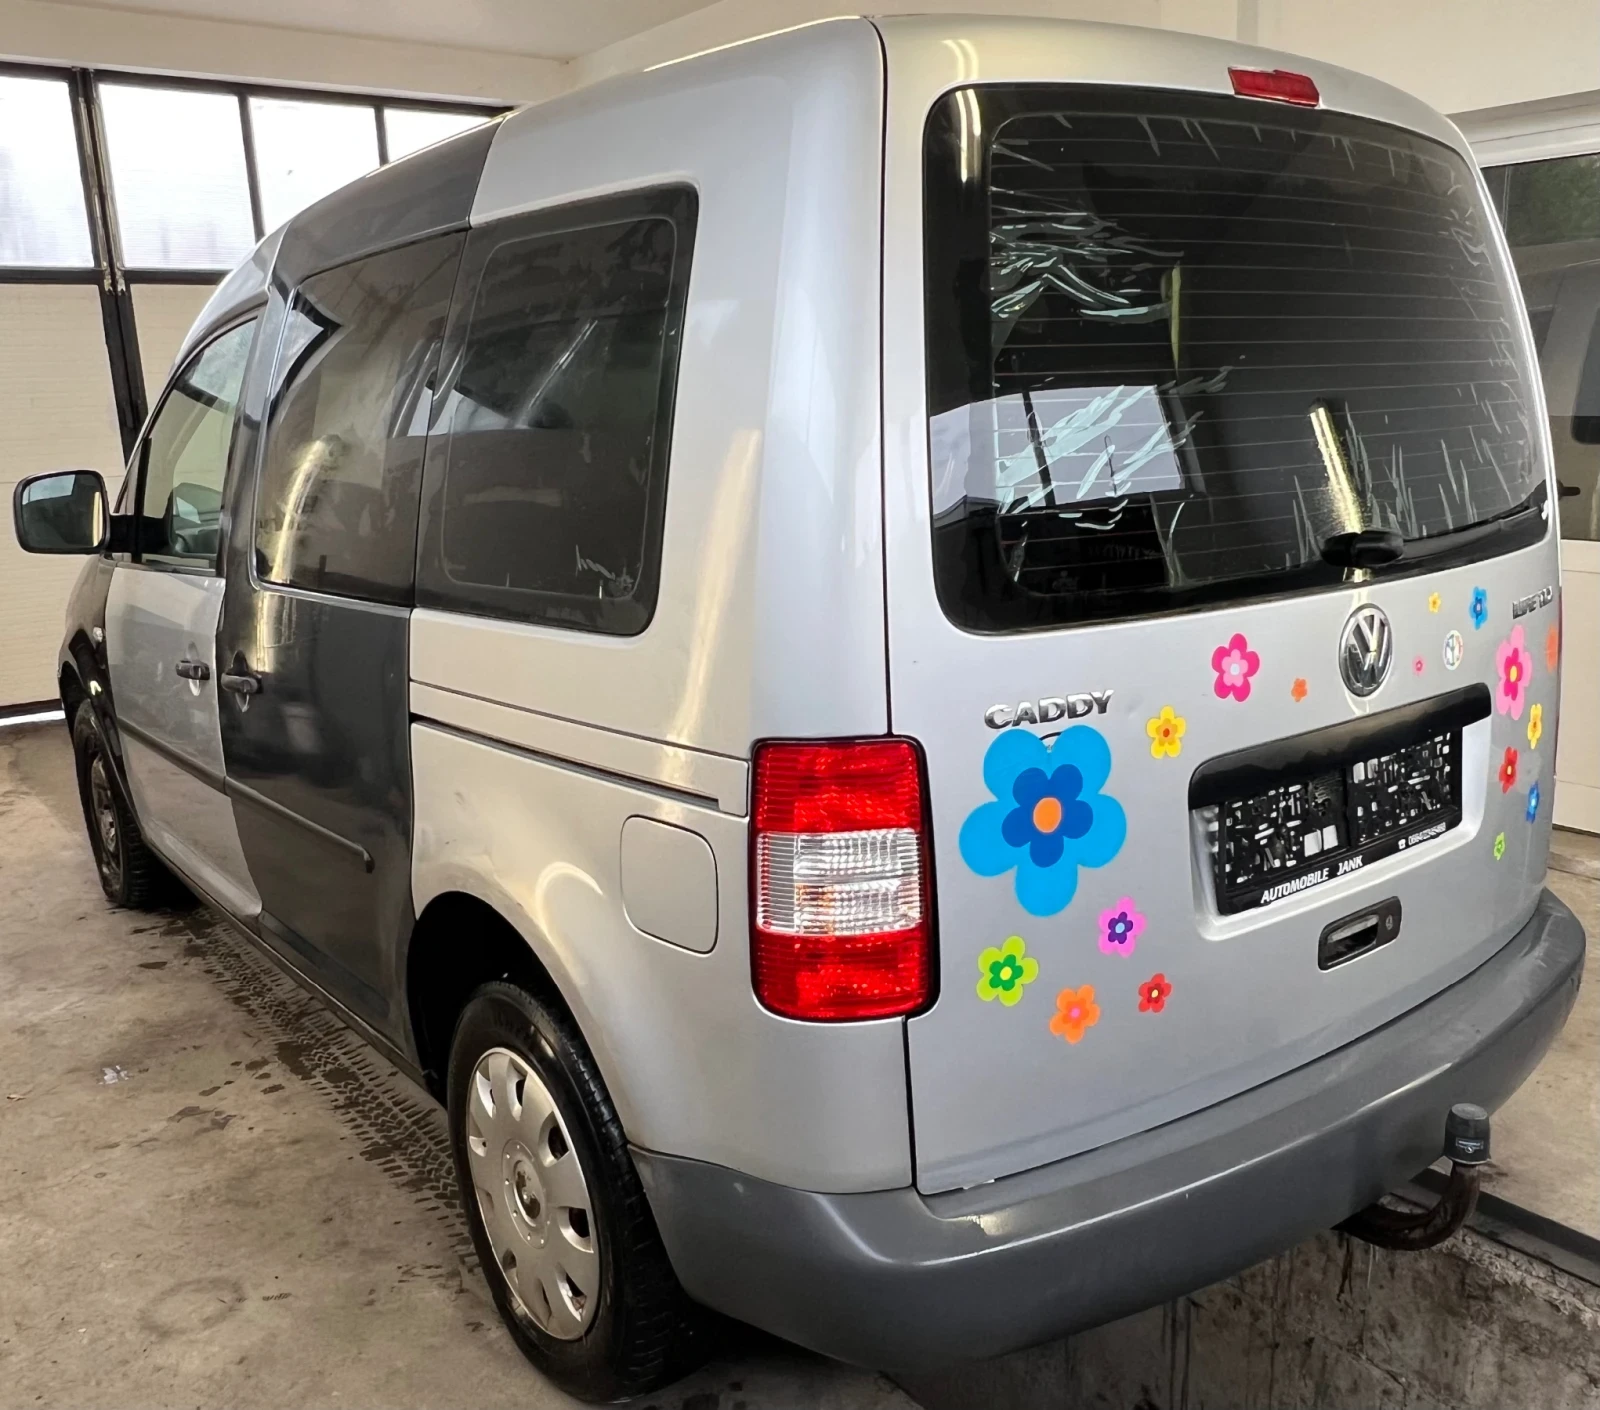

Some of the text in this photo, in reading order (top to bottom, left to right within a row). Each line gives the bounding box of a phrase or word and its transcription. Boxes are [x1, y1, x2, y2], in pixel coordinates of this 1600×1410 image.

[984, 689, 1115, 730] CADDY
[1260, 855, 1364, 904] AUTOMOBILE JANK
